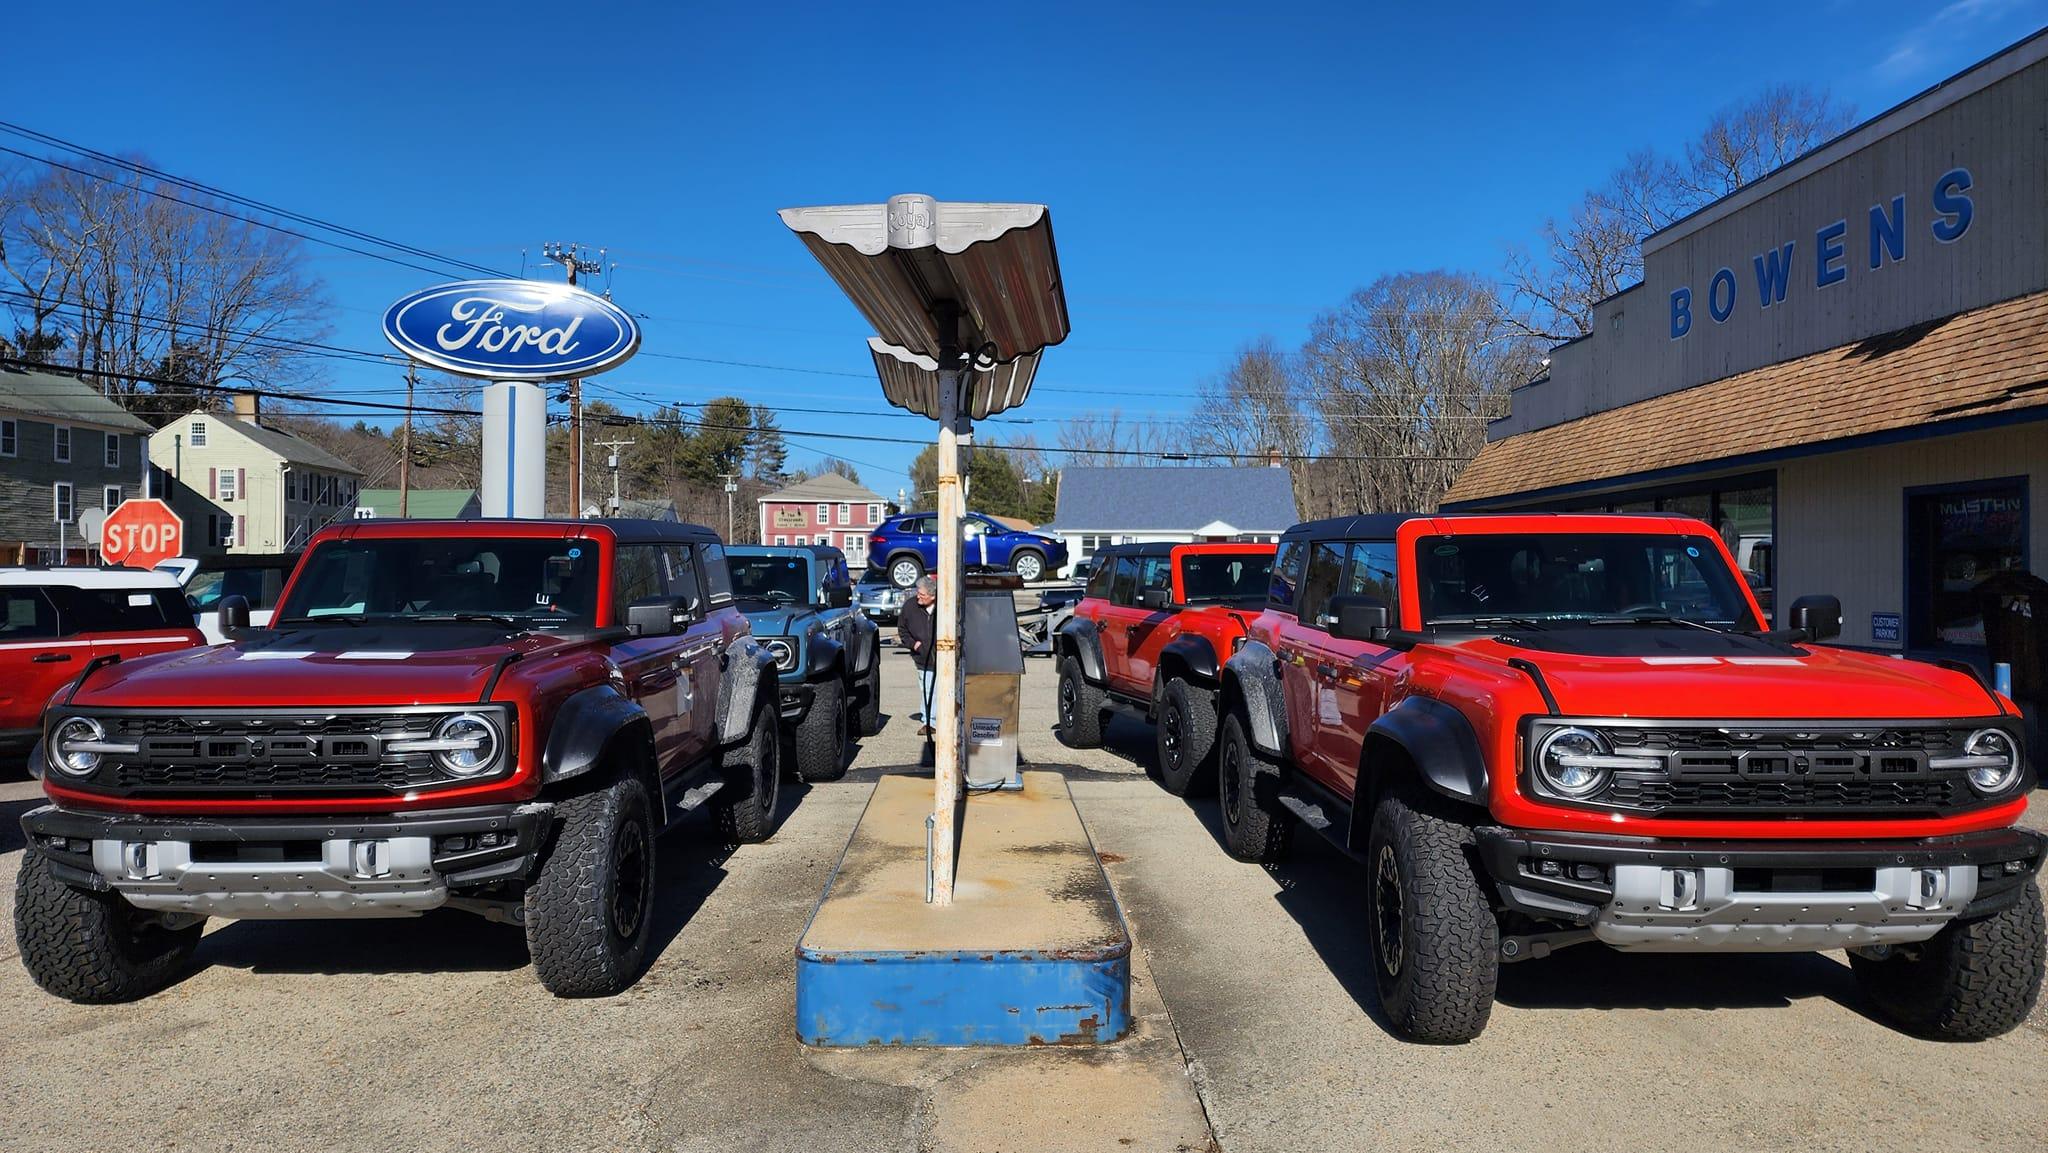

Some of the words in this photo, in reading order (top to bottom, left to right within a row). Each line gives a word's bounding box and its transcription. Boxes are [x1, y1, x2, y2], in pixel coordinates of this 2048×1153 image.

[888, 209, 931, 234] Royal
[1669, 167, 1974, 342] BOWENS
[437, 297, 583, 356] Ford
[106, 523, 177, 554] STOP
[1875, 628, 1897, 640] PARKING
[139, 735, 381, 764] FORD
[1671, 750, 1929, 781] FORD
